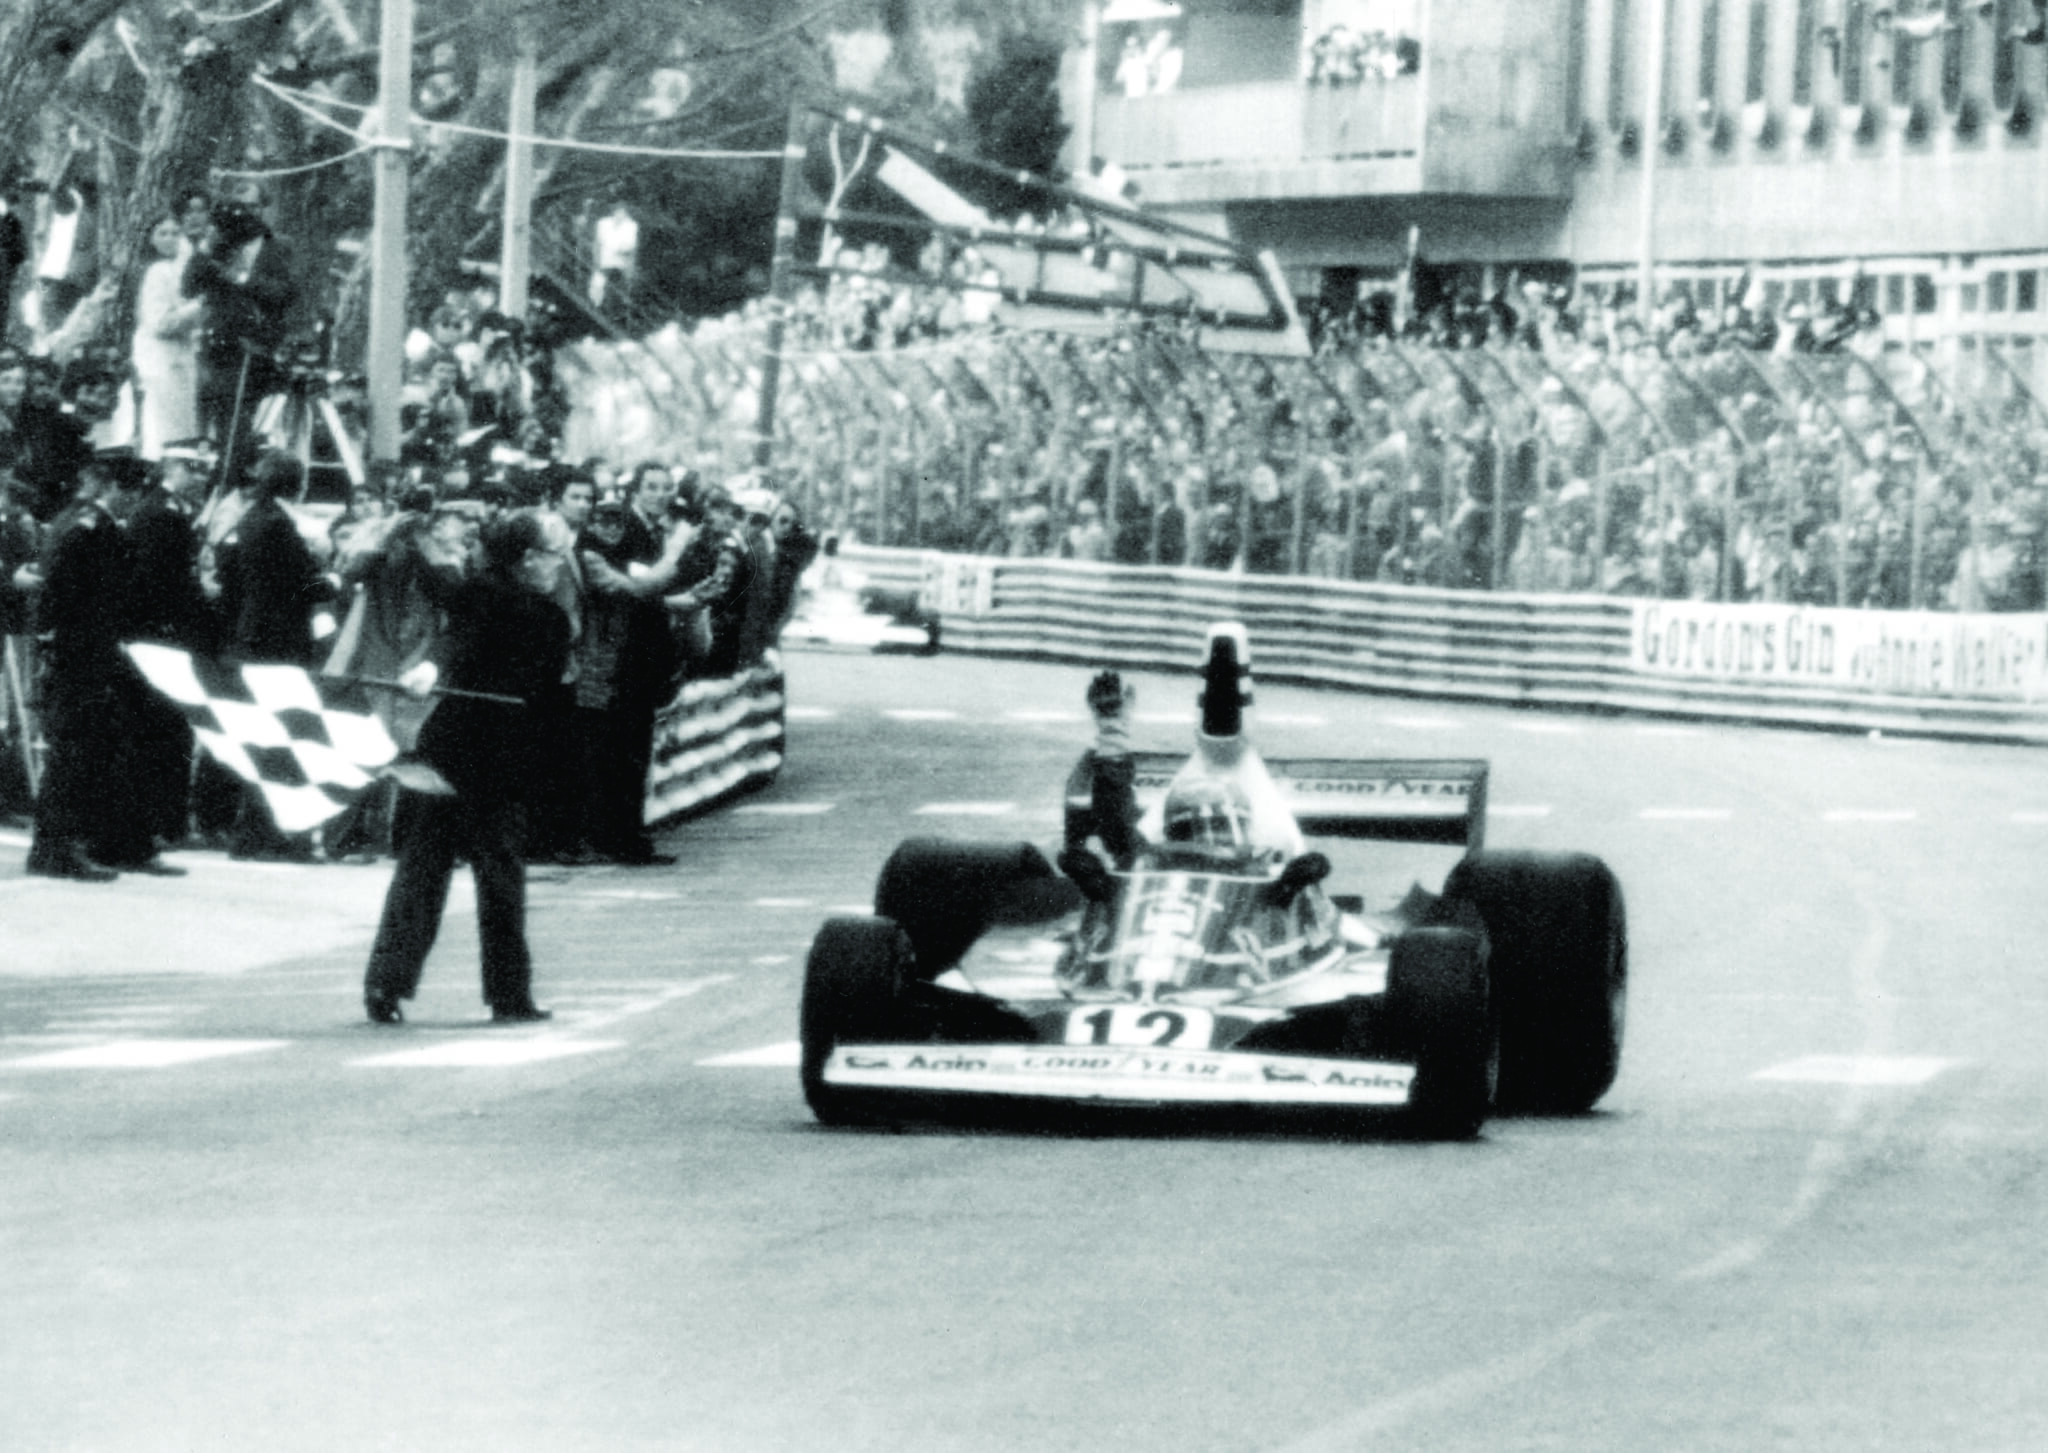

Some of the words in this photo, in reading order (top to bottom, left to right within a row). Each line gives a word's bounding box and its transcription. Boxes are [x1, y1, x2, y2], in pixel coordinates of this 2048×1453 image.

[1785, 612, 1835, 675] Gin
[1084, 1008, 1187, 1047] 12
[1022, 1055, 1111, 1070] GOOD
